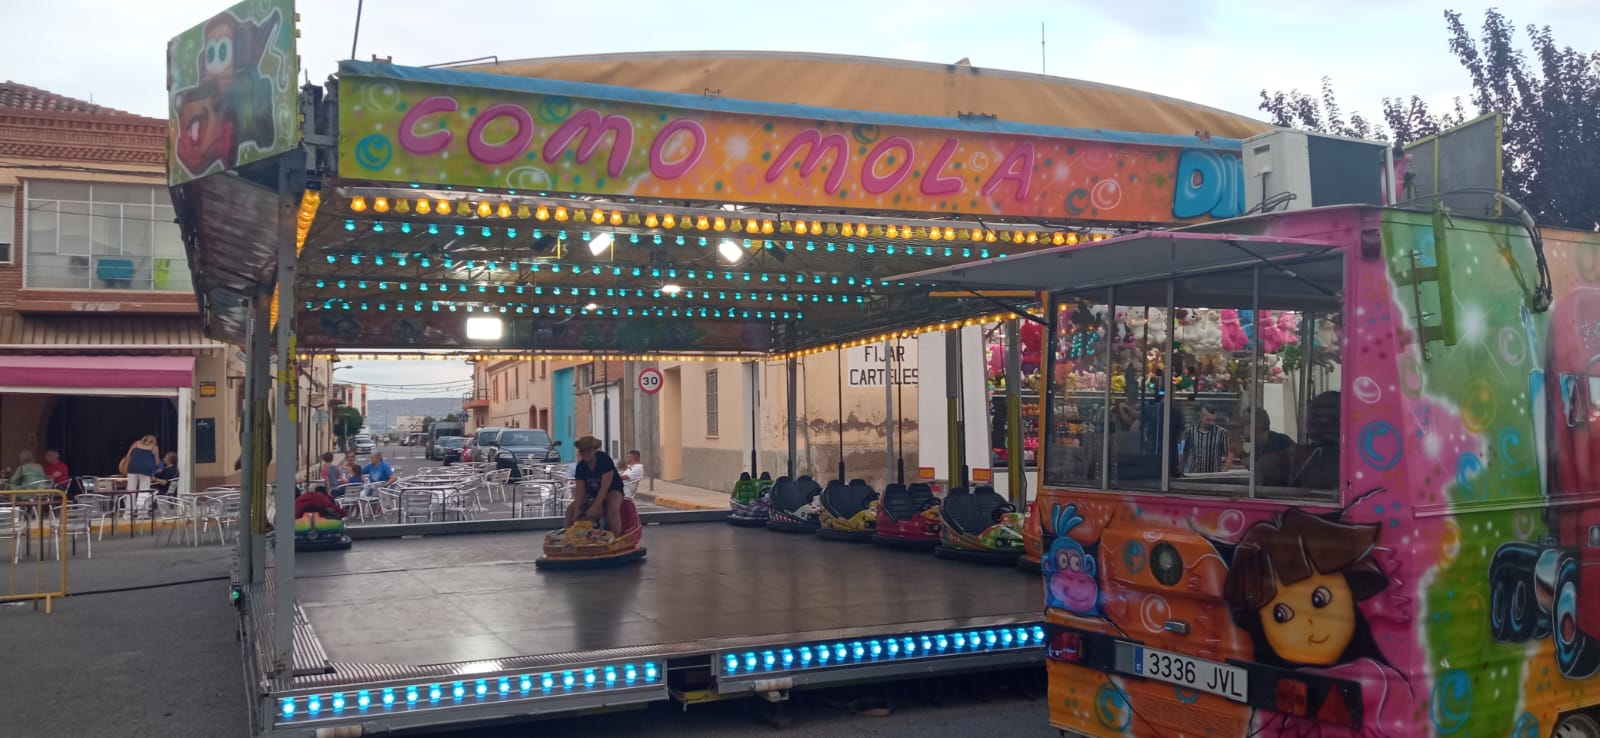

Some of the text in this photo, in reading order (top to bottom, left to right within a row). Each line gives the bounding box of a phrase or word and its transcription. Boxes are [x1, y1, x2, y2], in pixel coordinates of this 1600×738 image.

[398, 95, 707, 181] COMO
[765, 128, 1035, 202] MOLA
[864, 345, 905, 362] FIJAR
[642, 376, 659, 386] 30
[1149, 652, 1196, 684] 3336
[1206, 666, 1243, 697] JVL
